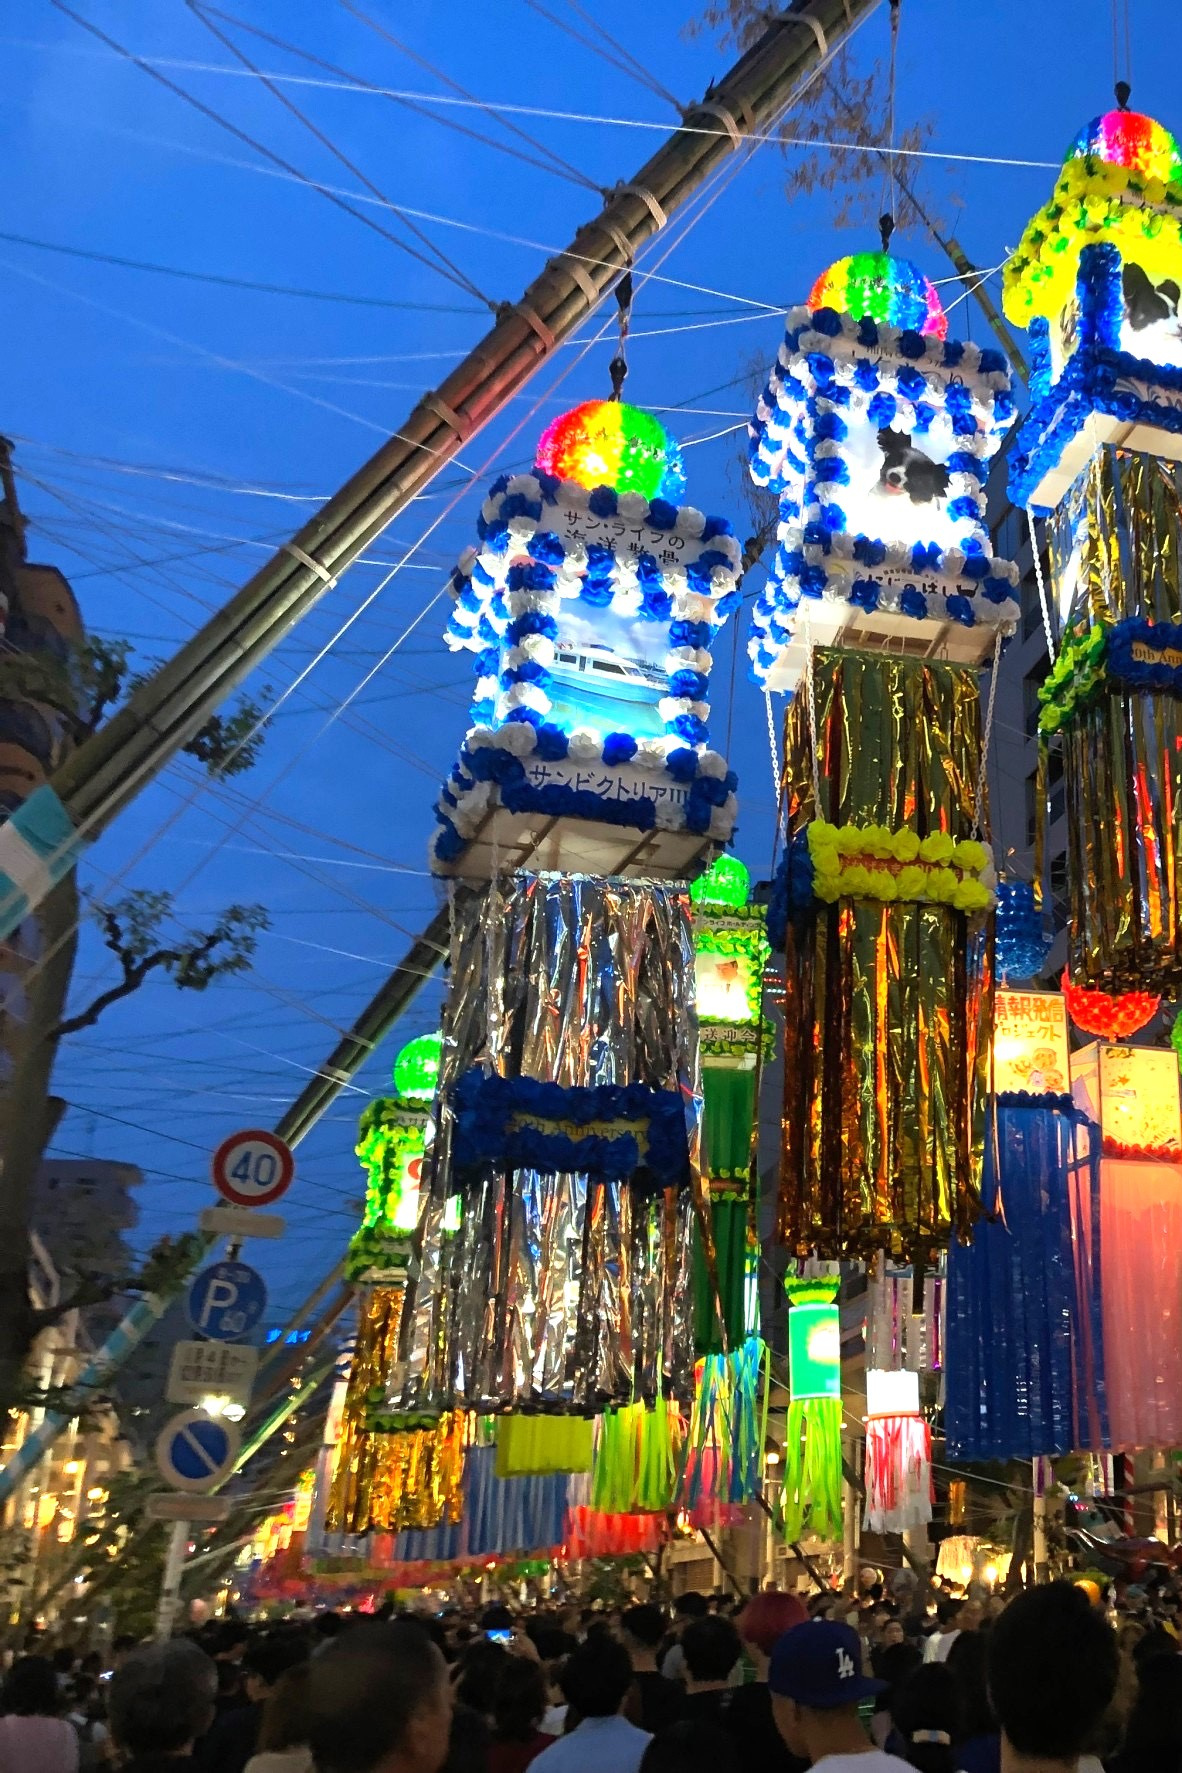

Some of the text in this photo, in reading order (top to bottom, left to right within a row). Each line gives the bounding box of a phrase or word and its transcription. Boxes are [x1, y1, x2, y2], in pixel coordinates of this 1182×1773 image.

[564, 511, 685, 550] サン・ライフの
[998, 1021, 1062, 1041] ロジェクト
[231, 1152, 277, 1187] 40
[199, 1279, 239, 1328] P
[835, 1647, 855, 1679] LA
